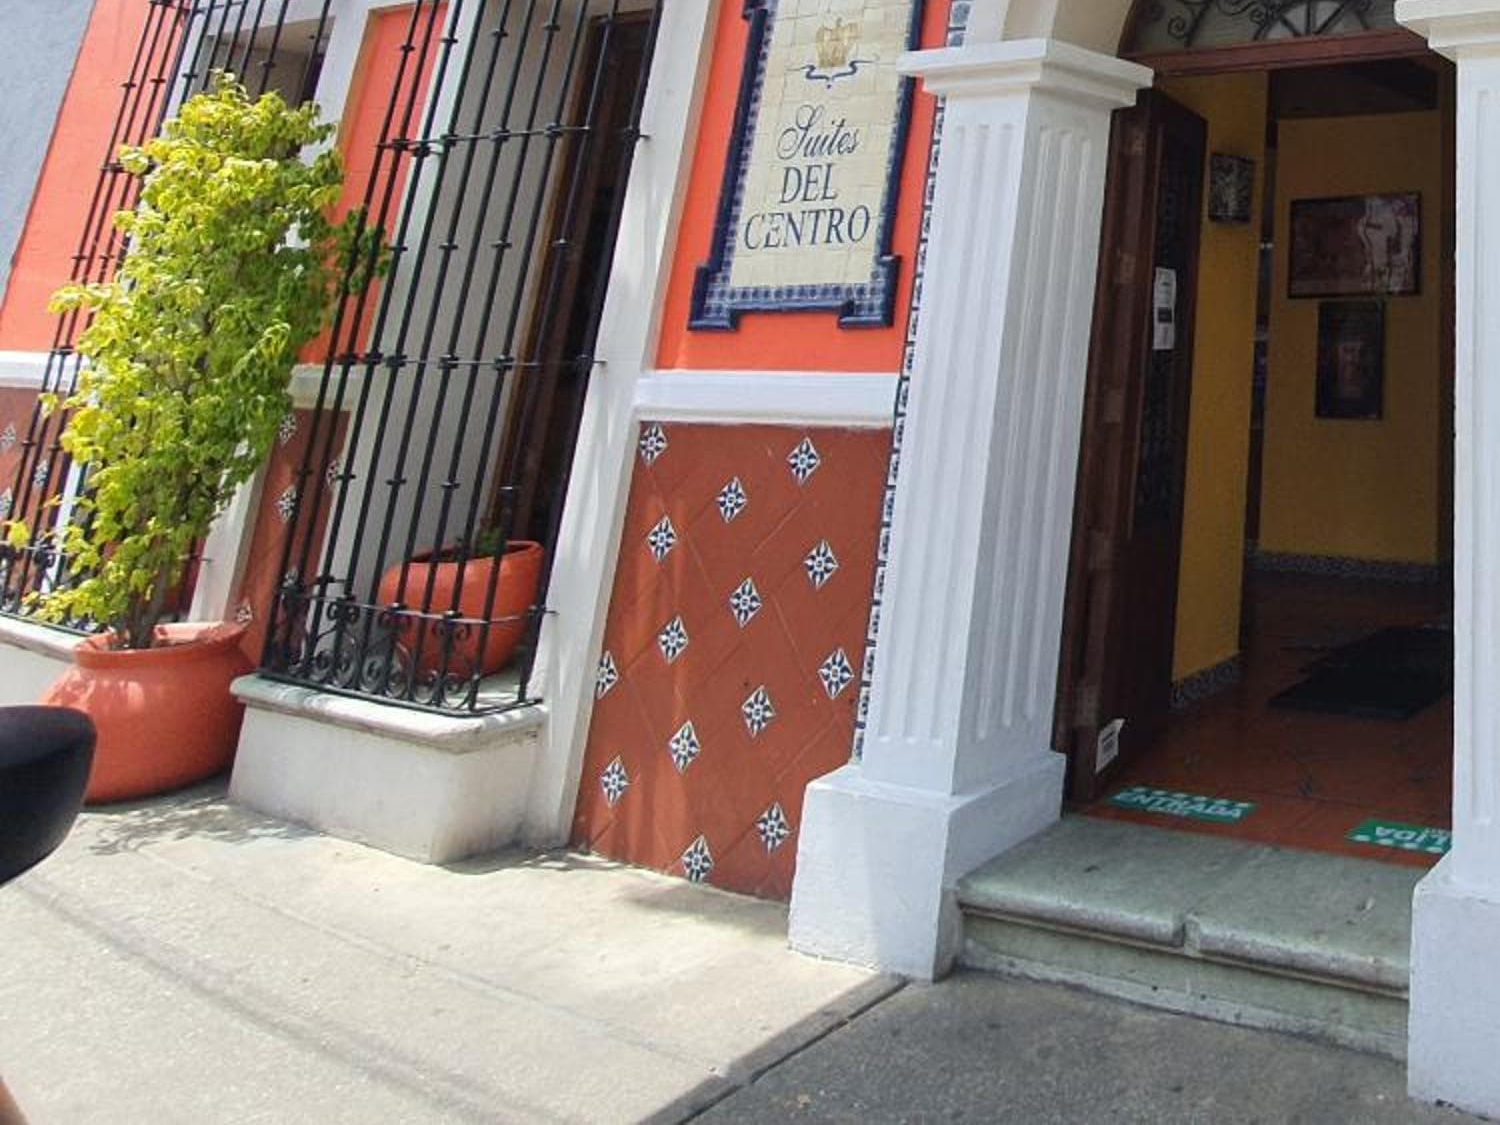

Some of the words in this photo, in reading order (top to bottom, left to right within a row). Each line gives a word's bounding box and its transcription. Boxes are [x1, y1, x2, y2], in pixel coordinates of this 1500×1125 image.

[777, 104, 860, 160] Suites
[779, 162, 838, 204] DEL
[743, 204, 870, 249] CENTRO
[1112, 792, 1242, 818] ENTRADA
[1375, 826, 1450, 845] LIDA
